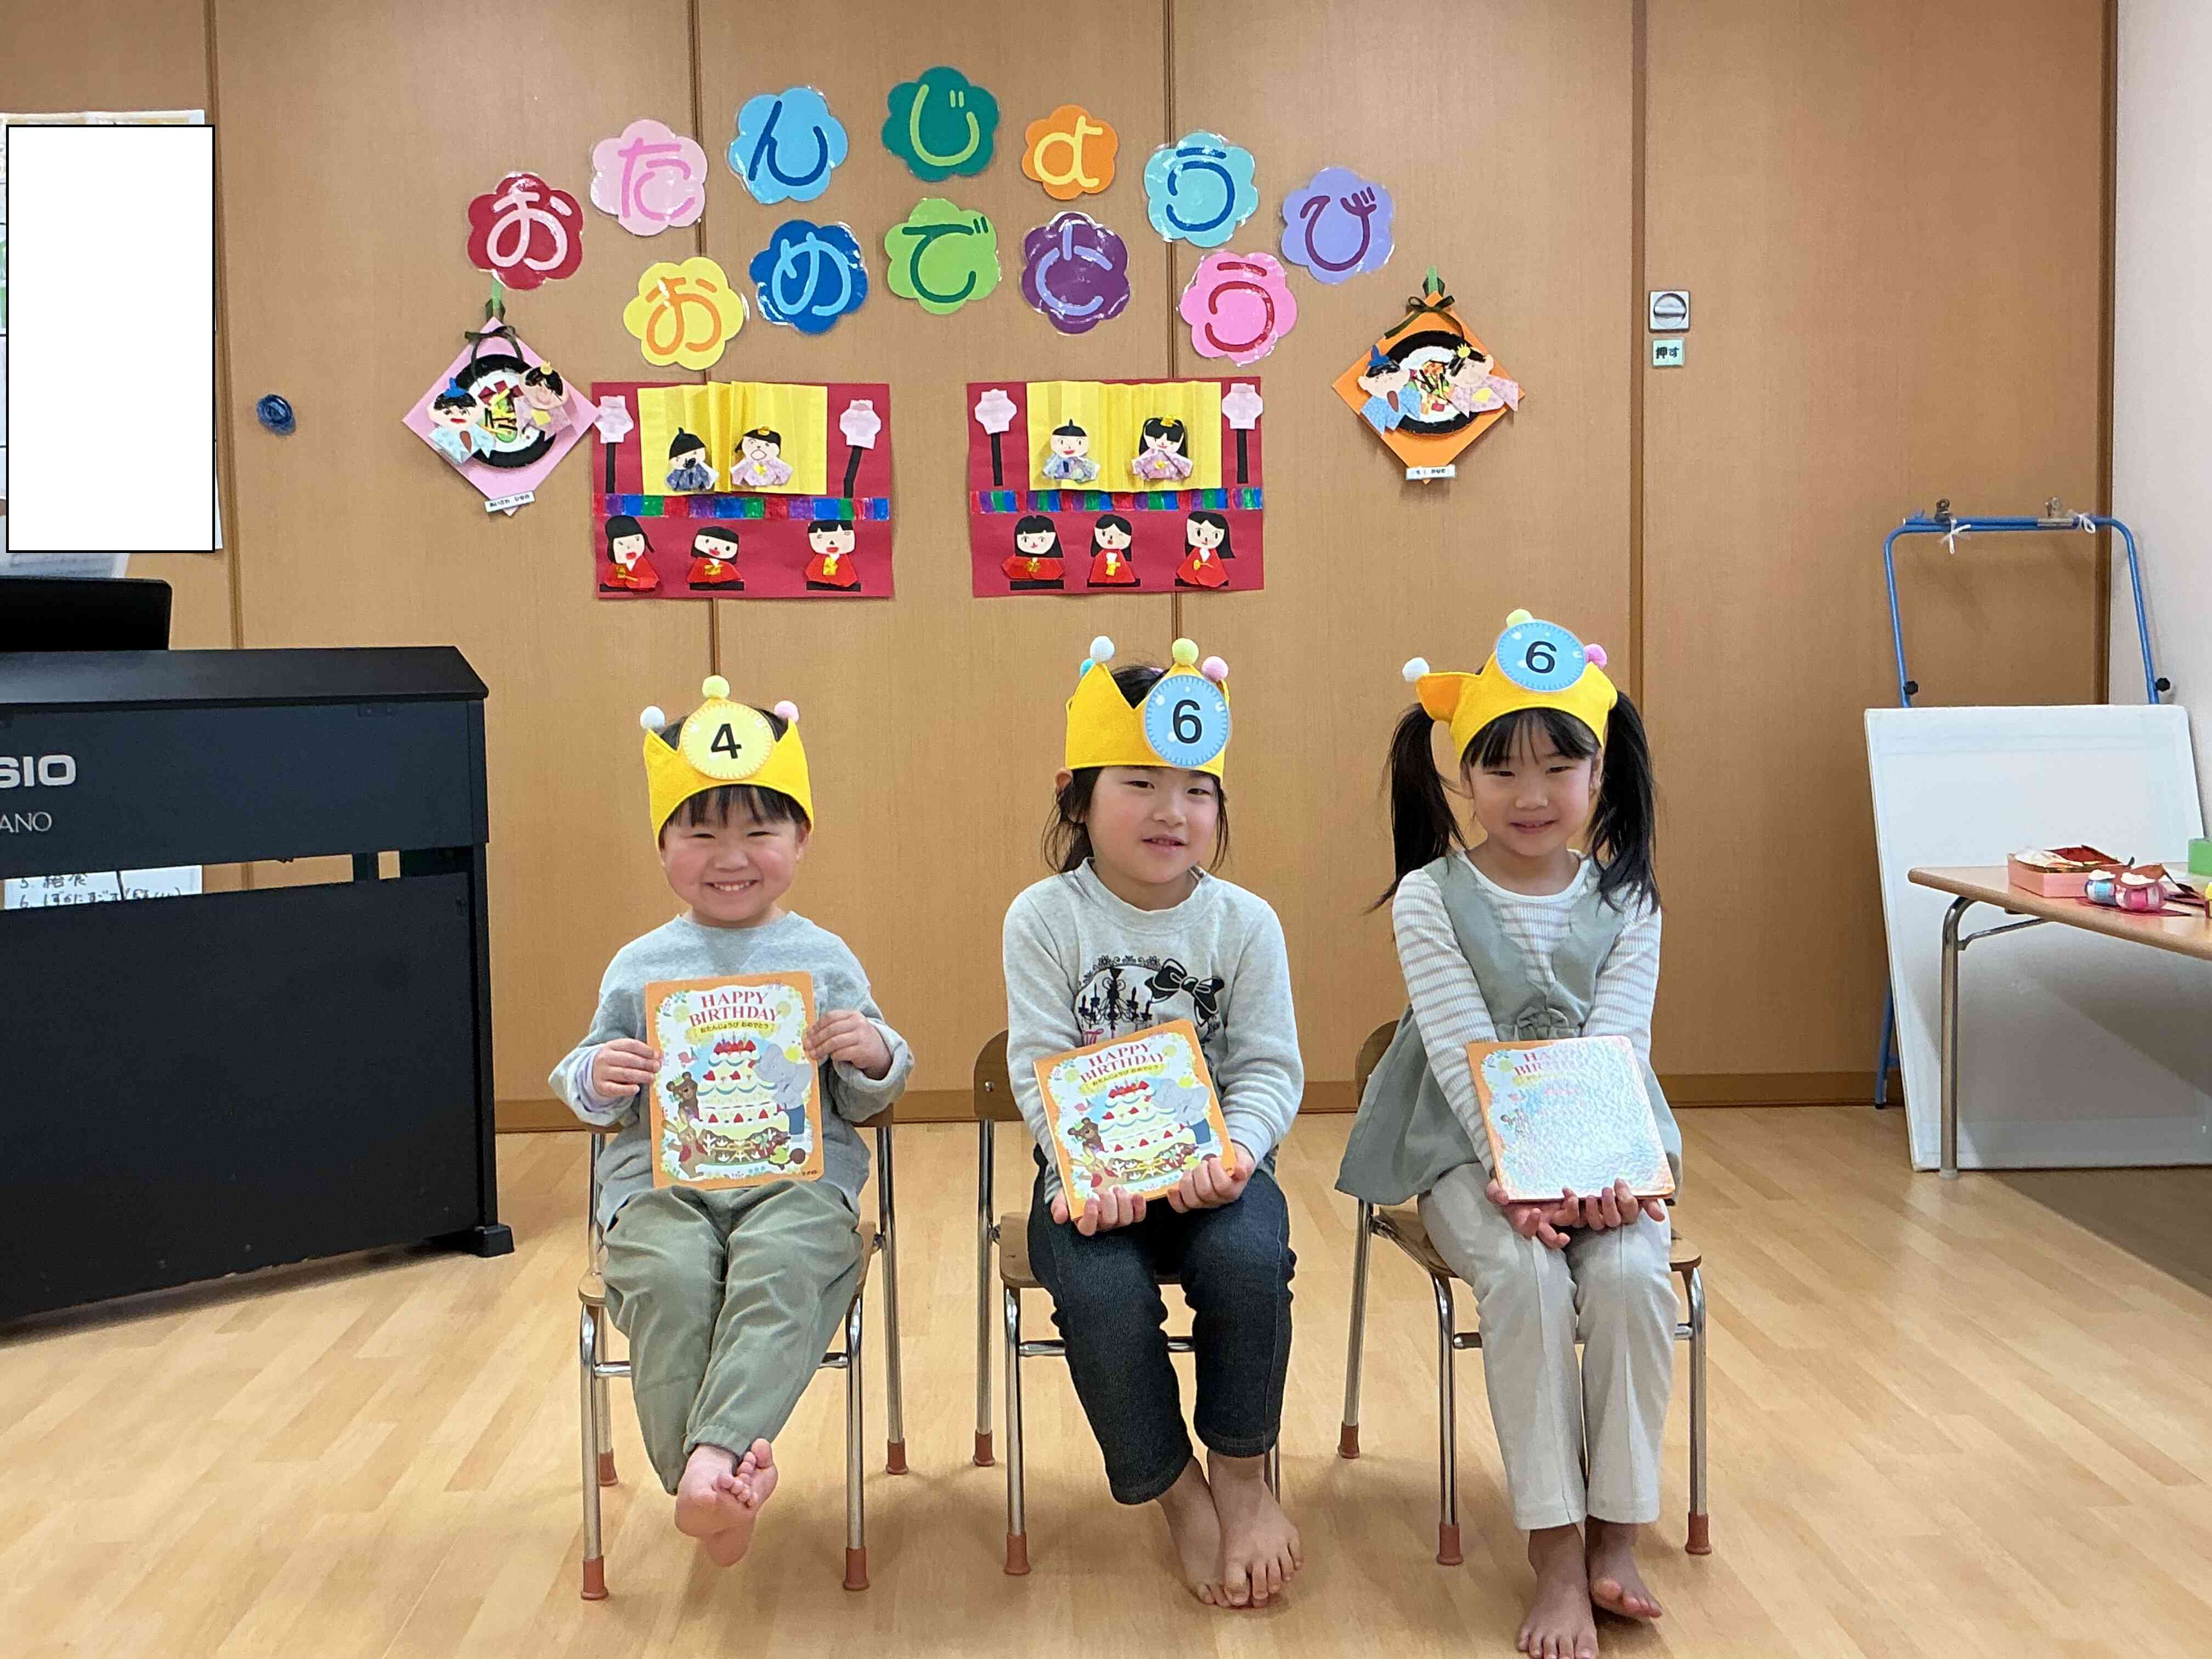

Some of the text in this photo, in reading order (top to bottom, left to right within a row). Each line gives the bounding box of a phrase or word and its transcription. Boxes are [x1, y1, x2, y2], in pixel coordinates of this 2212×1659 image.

[646, 216, 1275, 356] おめでとう
[1655, 346, 1680, 359] 押す
[1525, 640, 1557, 674] 6
[1172, 699, 1203, 744] 6
[710, 723, 742, 759] 4
[701, 991, 769, 1009] HAPPY
[689, 1005, 781, 1027] BIRTHDAY
[701, 1022, 739, 1033] おたんじょうび
[1080, 1052, 1167, 1083] BIRTHDAY
[1088, 1043, 1152, 1067] HAPPY
